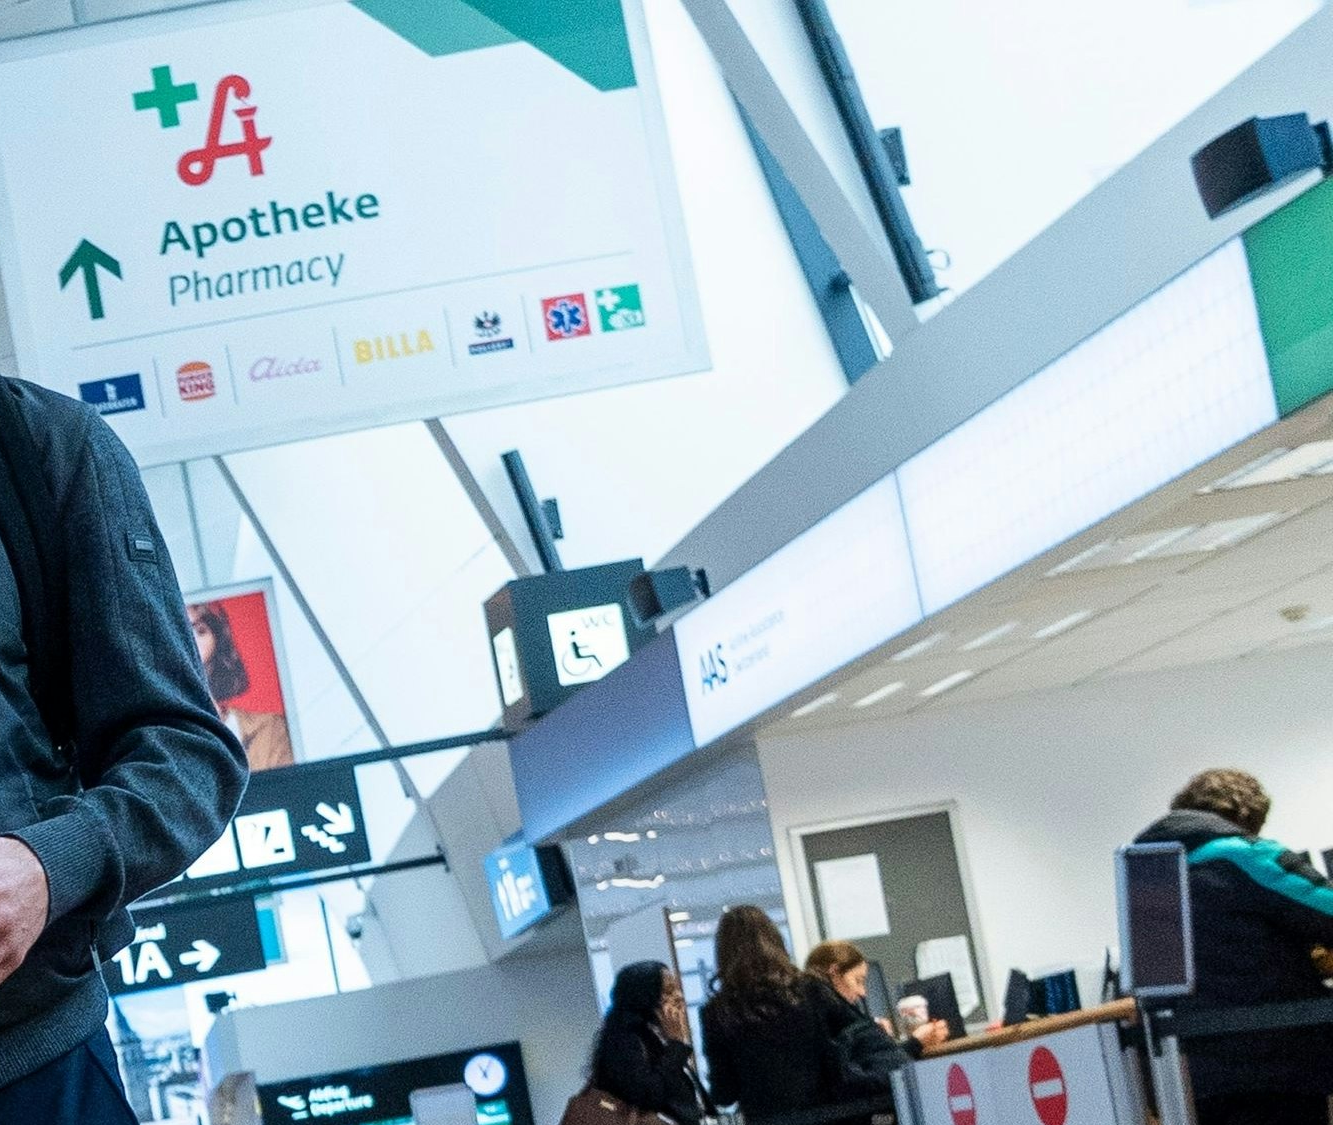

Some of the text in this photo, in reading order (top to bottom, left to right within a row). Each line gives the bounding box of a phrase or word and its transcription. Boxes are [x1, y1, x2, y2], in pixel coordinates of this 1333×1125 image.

[160, 191, 379, 258] Apotheke
[170, 253, 344, 306] Pharmacy
[353, 329, 434, 364] BILLA
[111, 941, 173, 985] 1A
